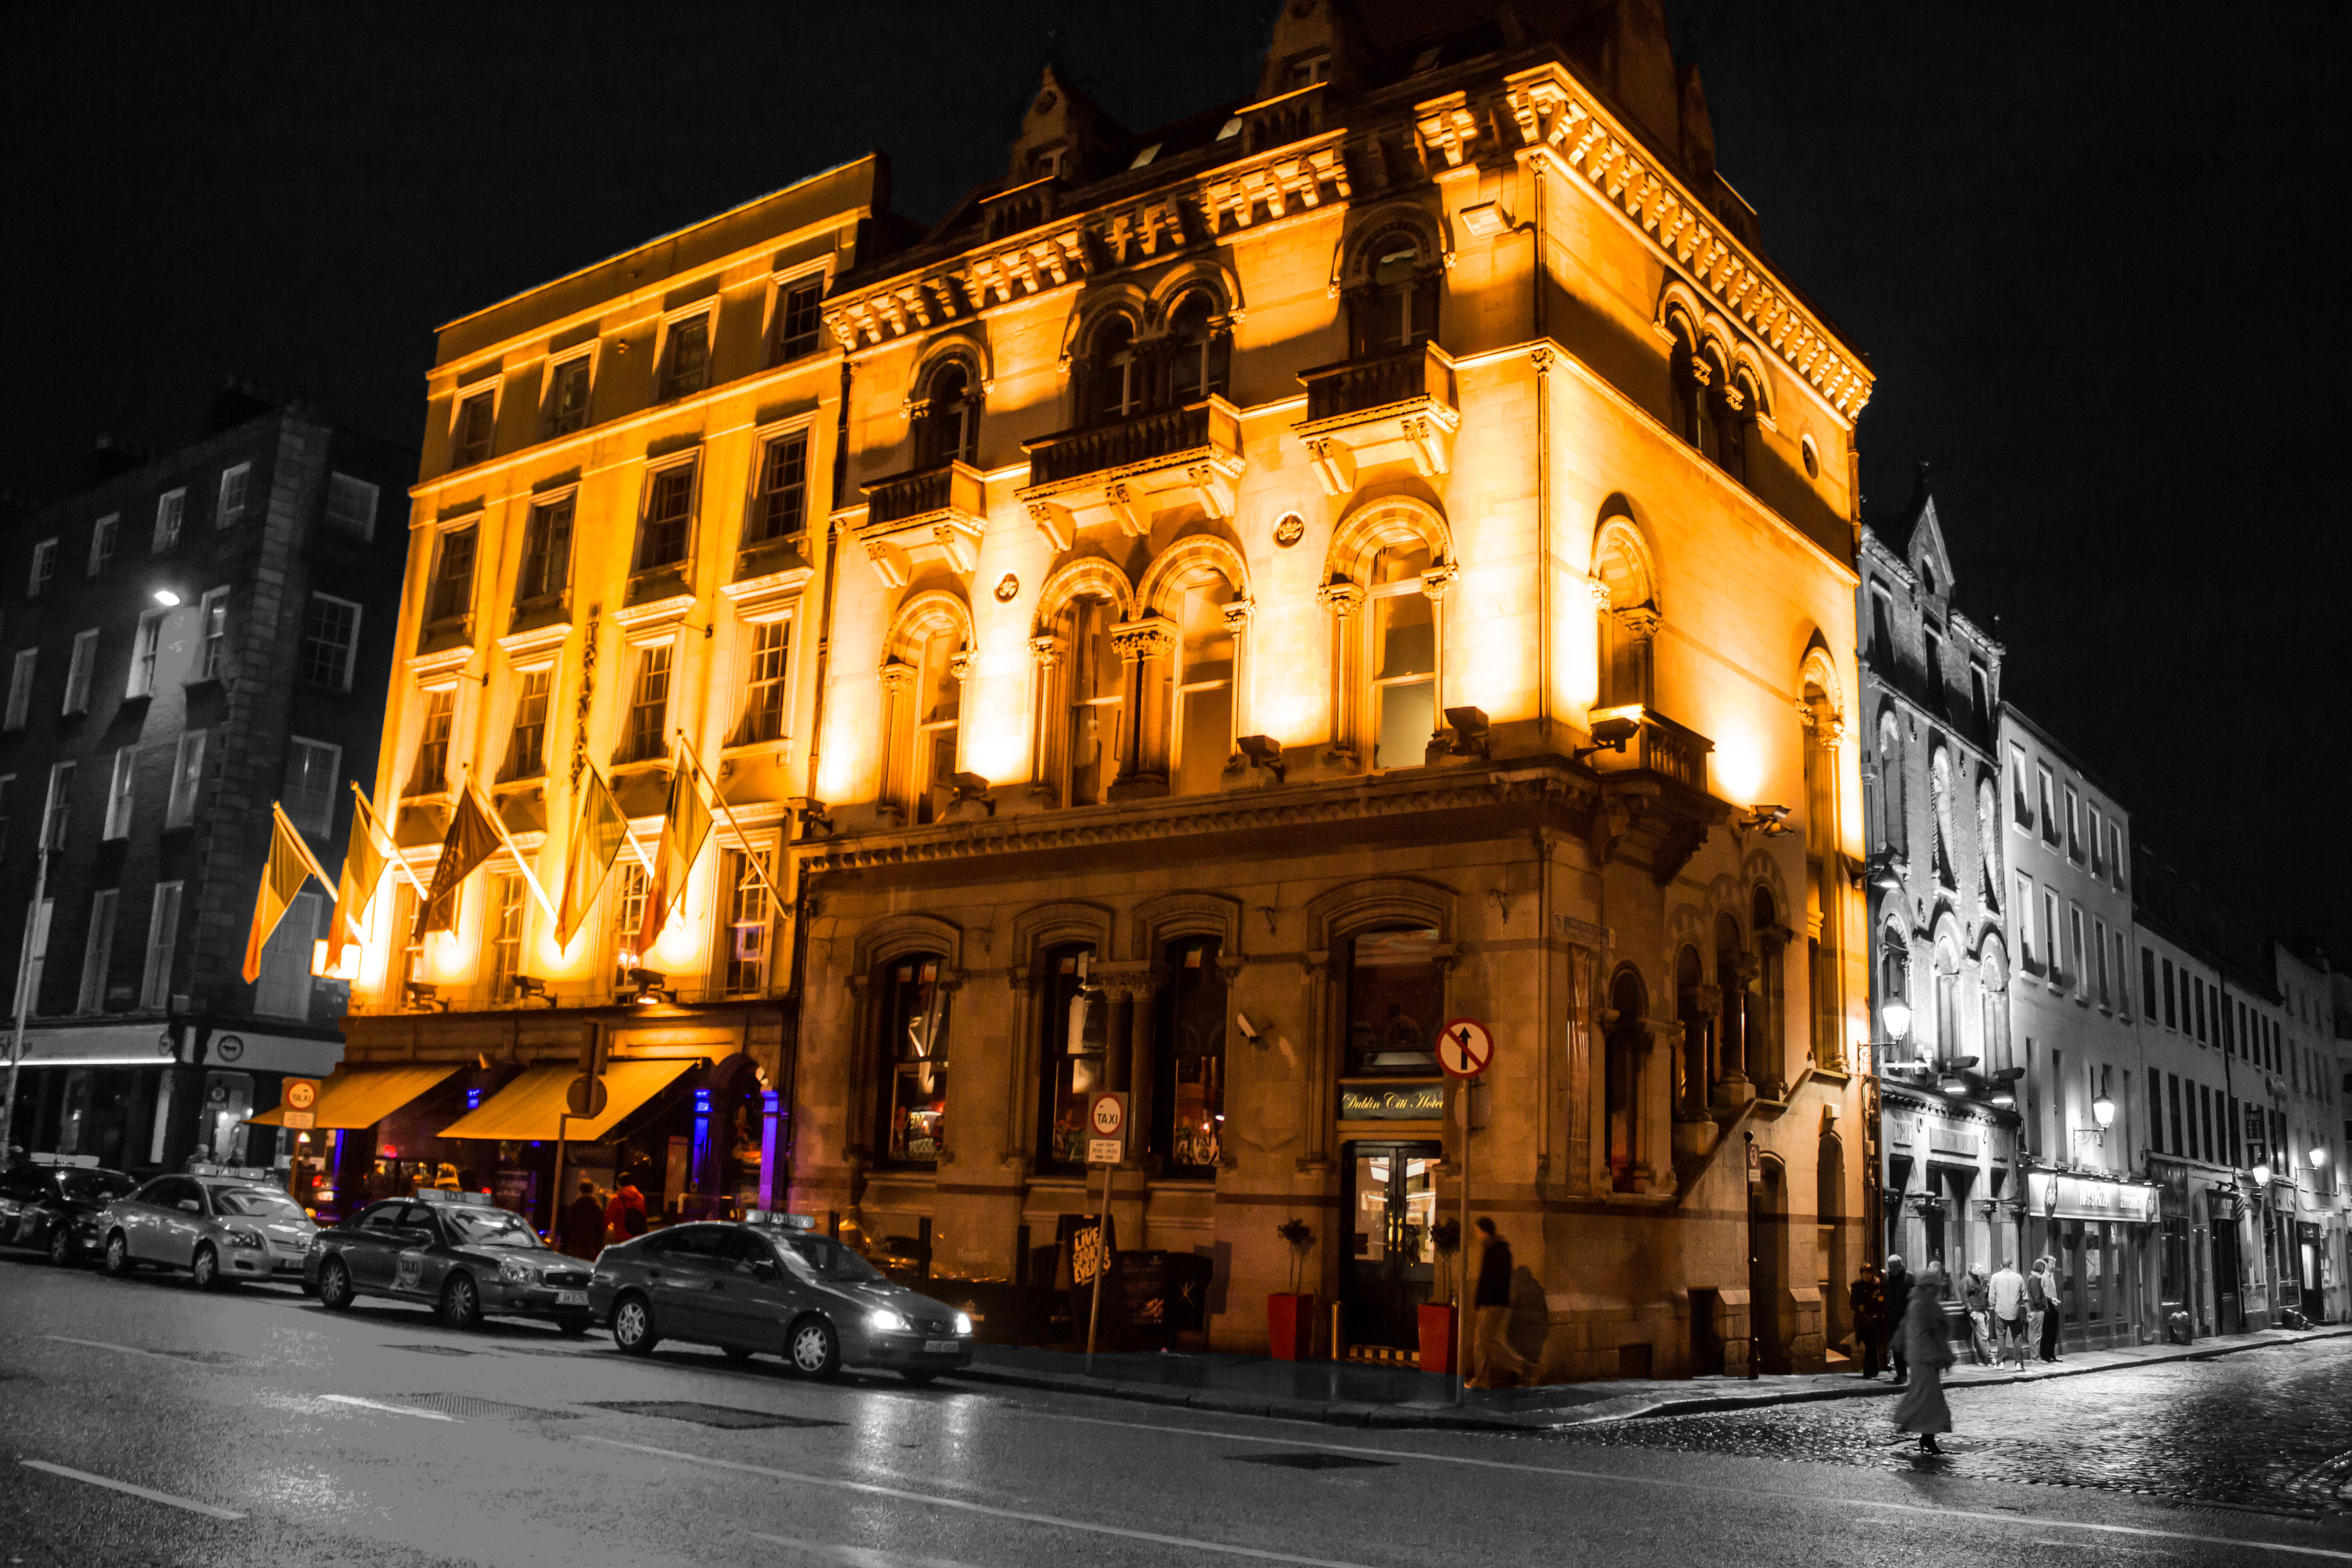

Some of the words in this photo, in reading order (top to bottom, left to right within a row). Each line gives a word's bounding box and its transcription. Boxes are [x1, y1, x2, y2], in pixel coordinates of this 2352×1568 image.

[292, 1093, 311, 1102] TAXI
[1343, 1093, 1381, 1109] Dublin
[1097, 1112, 1118, 1125] TAXI
[764, 1212, 789, 1225] TAXI
[1074, 1227, 1099, 1251] LIVE
[401, 1260, 419, 1274] TAXI
